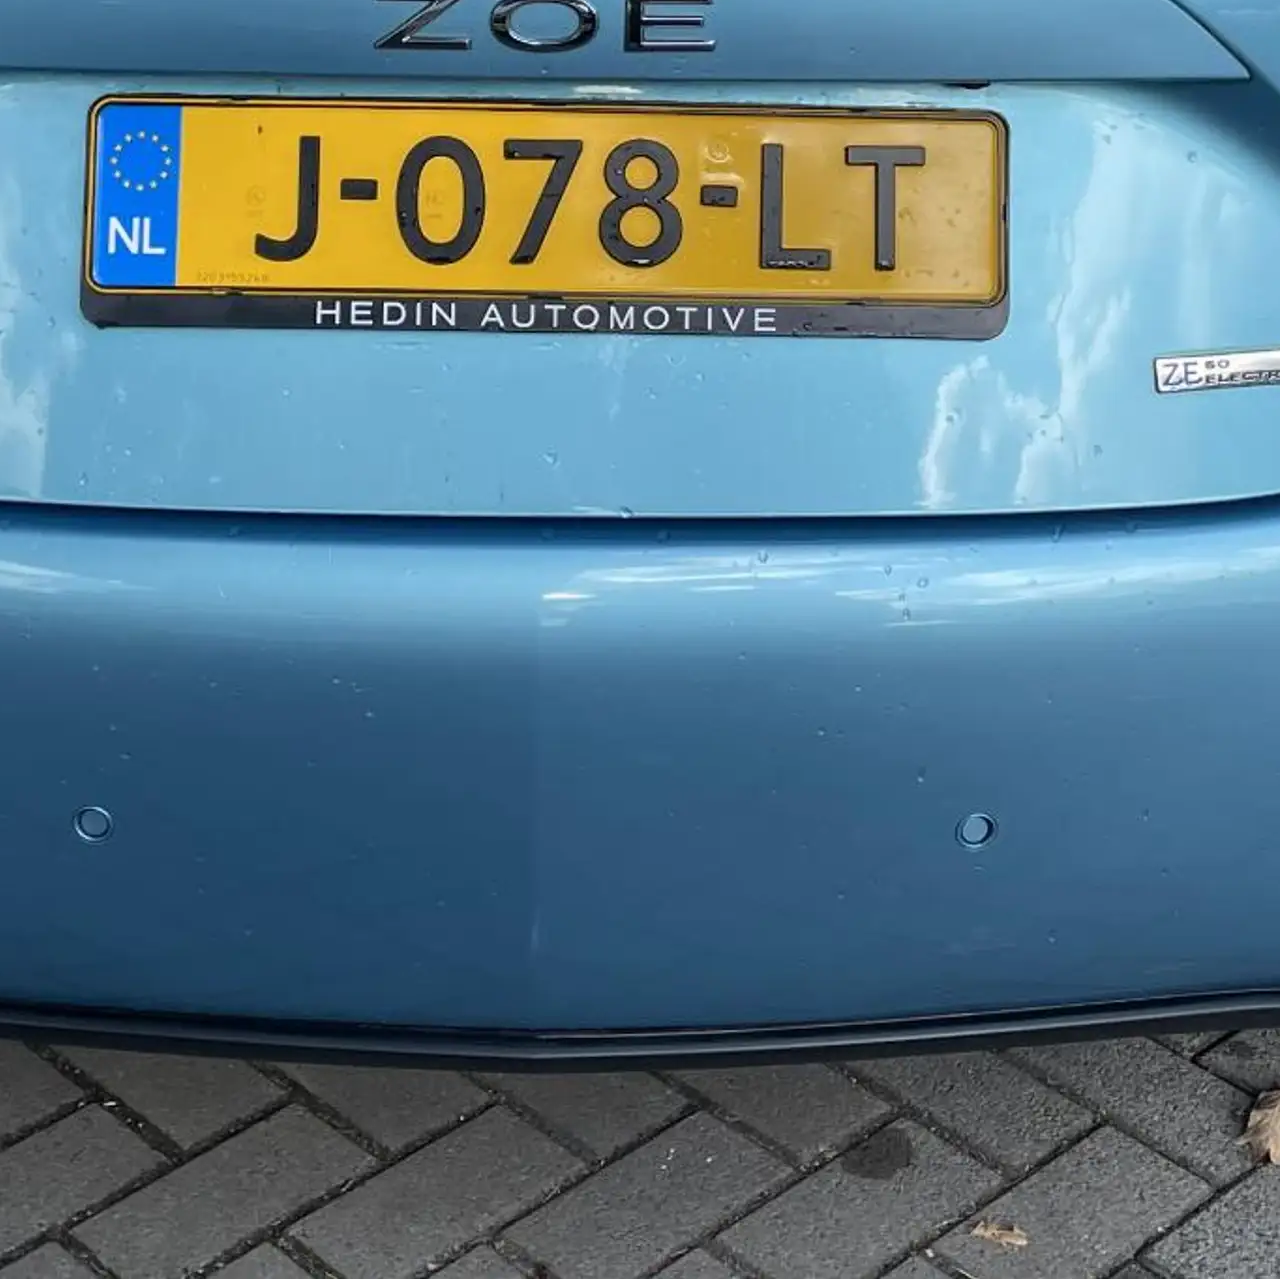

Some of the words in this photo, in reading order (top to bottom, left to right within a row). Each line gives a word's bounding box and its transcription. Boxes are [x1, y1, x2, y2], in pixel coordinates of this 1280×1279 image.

[253, 135, 926, 271] J-078-LT
[107, 217, 167, 255] NL
[315, 300, 459, 326] HEDIN
[482, 302, 778, 332] AUTOMOTIVE
